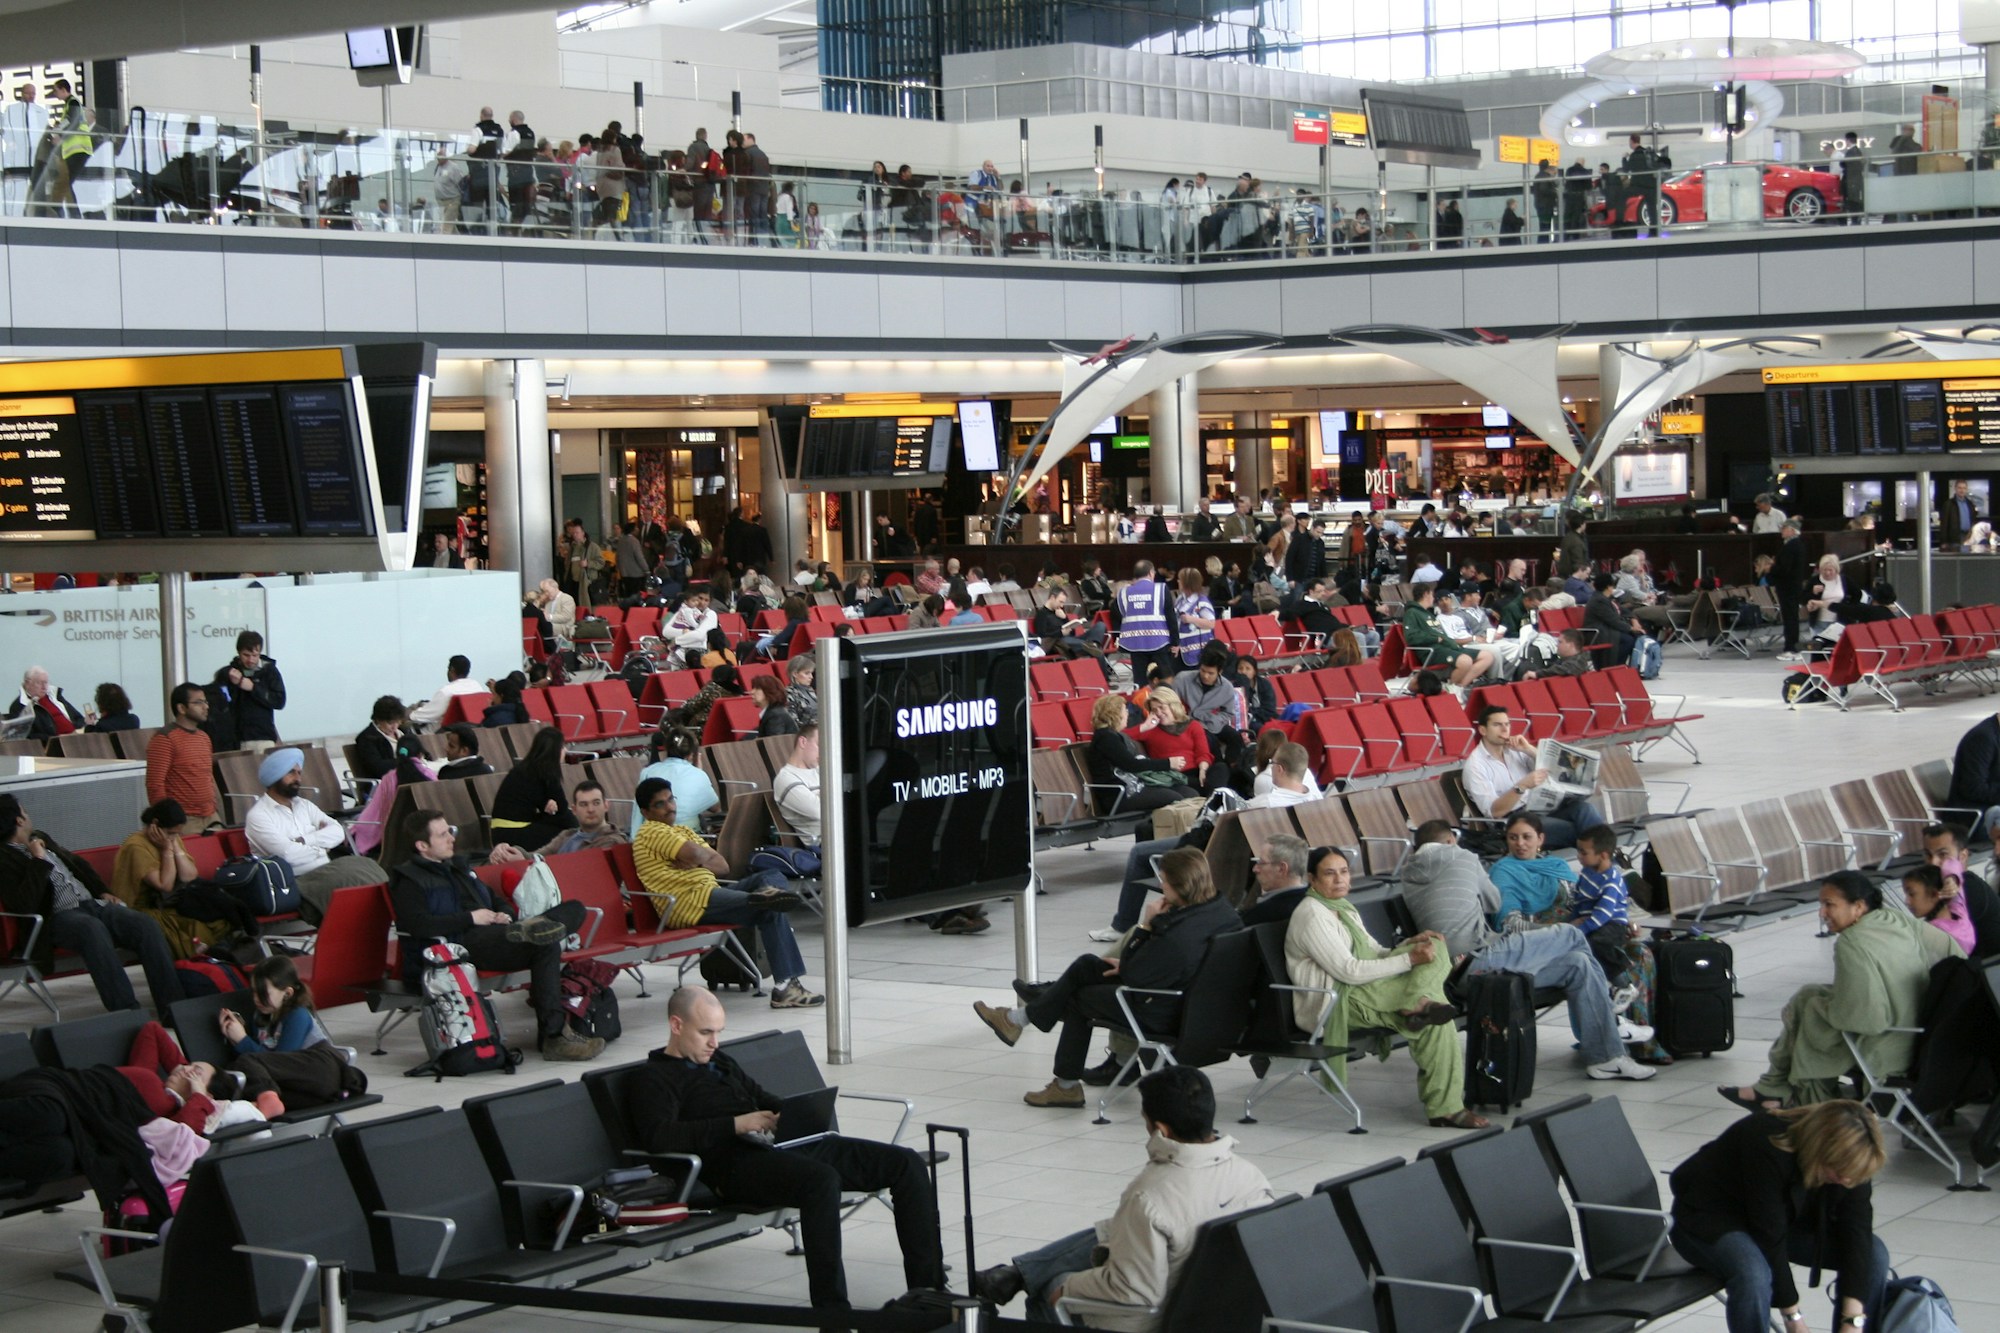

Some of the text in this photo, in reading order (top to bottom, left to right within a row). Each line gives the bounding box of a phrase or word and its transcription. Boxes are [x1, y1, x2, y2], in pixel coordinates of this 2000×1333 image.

[1820, 138, 1875, 151] SOY
[1775, 371, 1819, 380] Departures
[20, 432, 35, 441] your
[35, 431, 50, 441] gate
[35, 449, 61, 458] minutes
[39, 476, 66, 485] minutes
[1365, 469, 1397, 495] PRET
[44, 502, 70, 511] minutes
[1128, 594, 1152, 602] CUSTOMER
[1133, 601, 1146, 609] HOST
[63, 608, 125, 623] BRITISH
[64, 627, 128, 641] Customer
[896, 698, 997, 738] SAMSUNG
[892, 767, 1004, 803] TV MOBILE MP3
